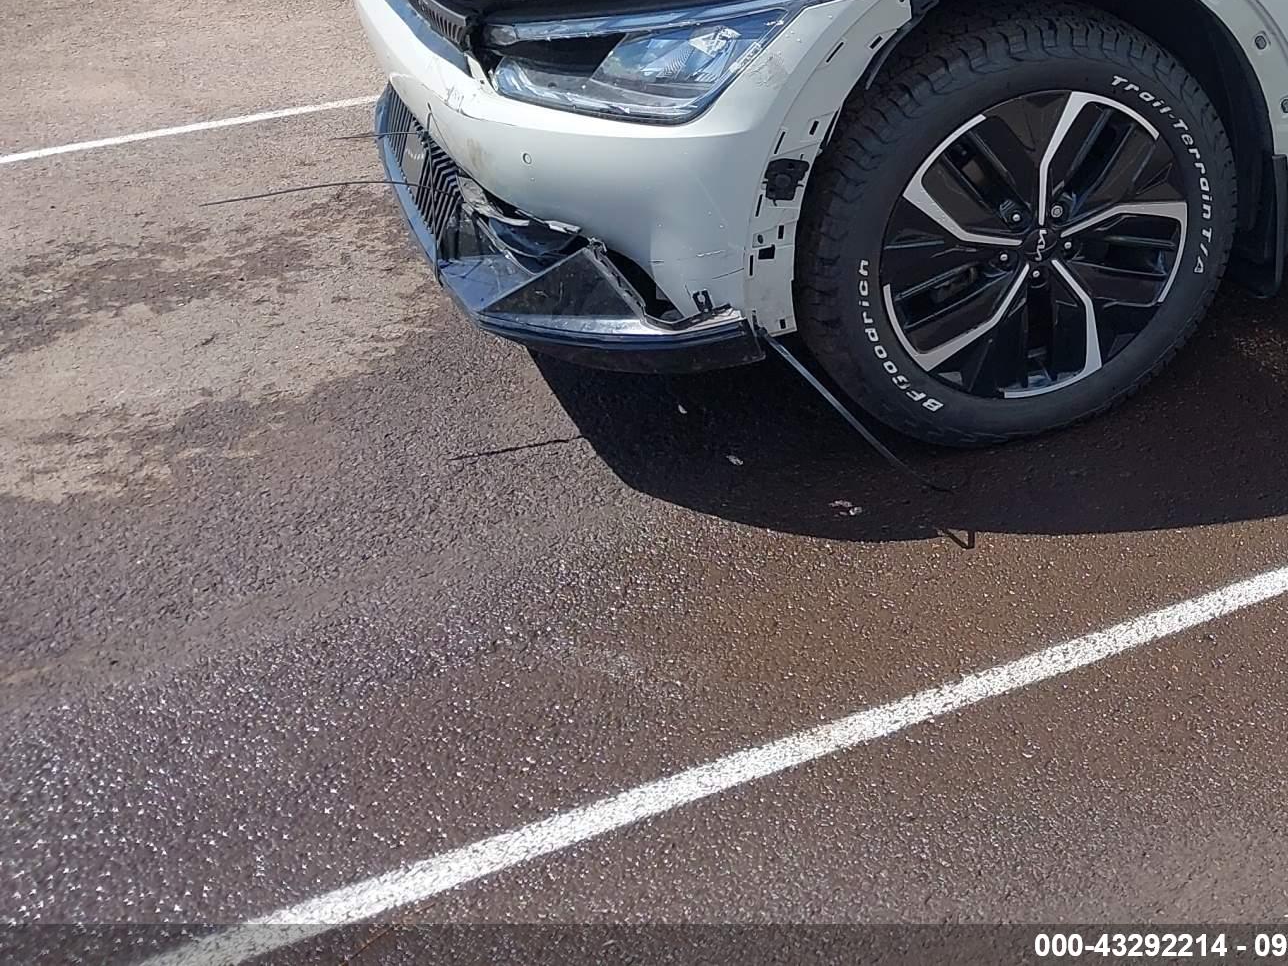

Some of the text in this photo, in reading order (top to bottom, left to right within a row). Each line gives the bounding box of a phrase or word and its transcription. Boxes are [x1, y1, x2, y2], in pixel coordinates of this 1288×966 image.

[1111, 74, 1214, 275] Trail-Terrain T/A
[858, 258, 945, 413] BFGoodrich
